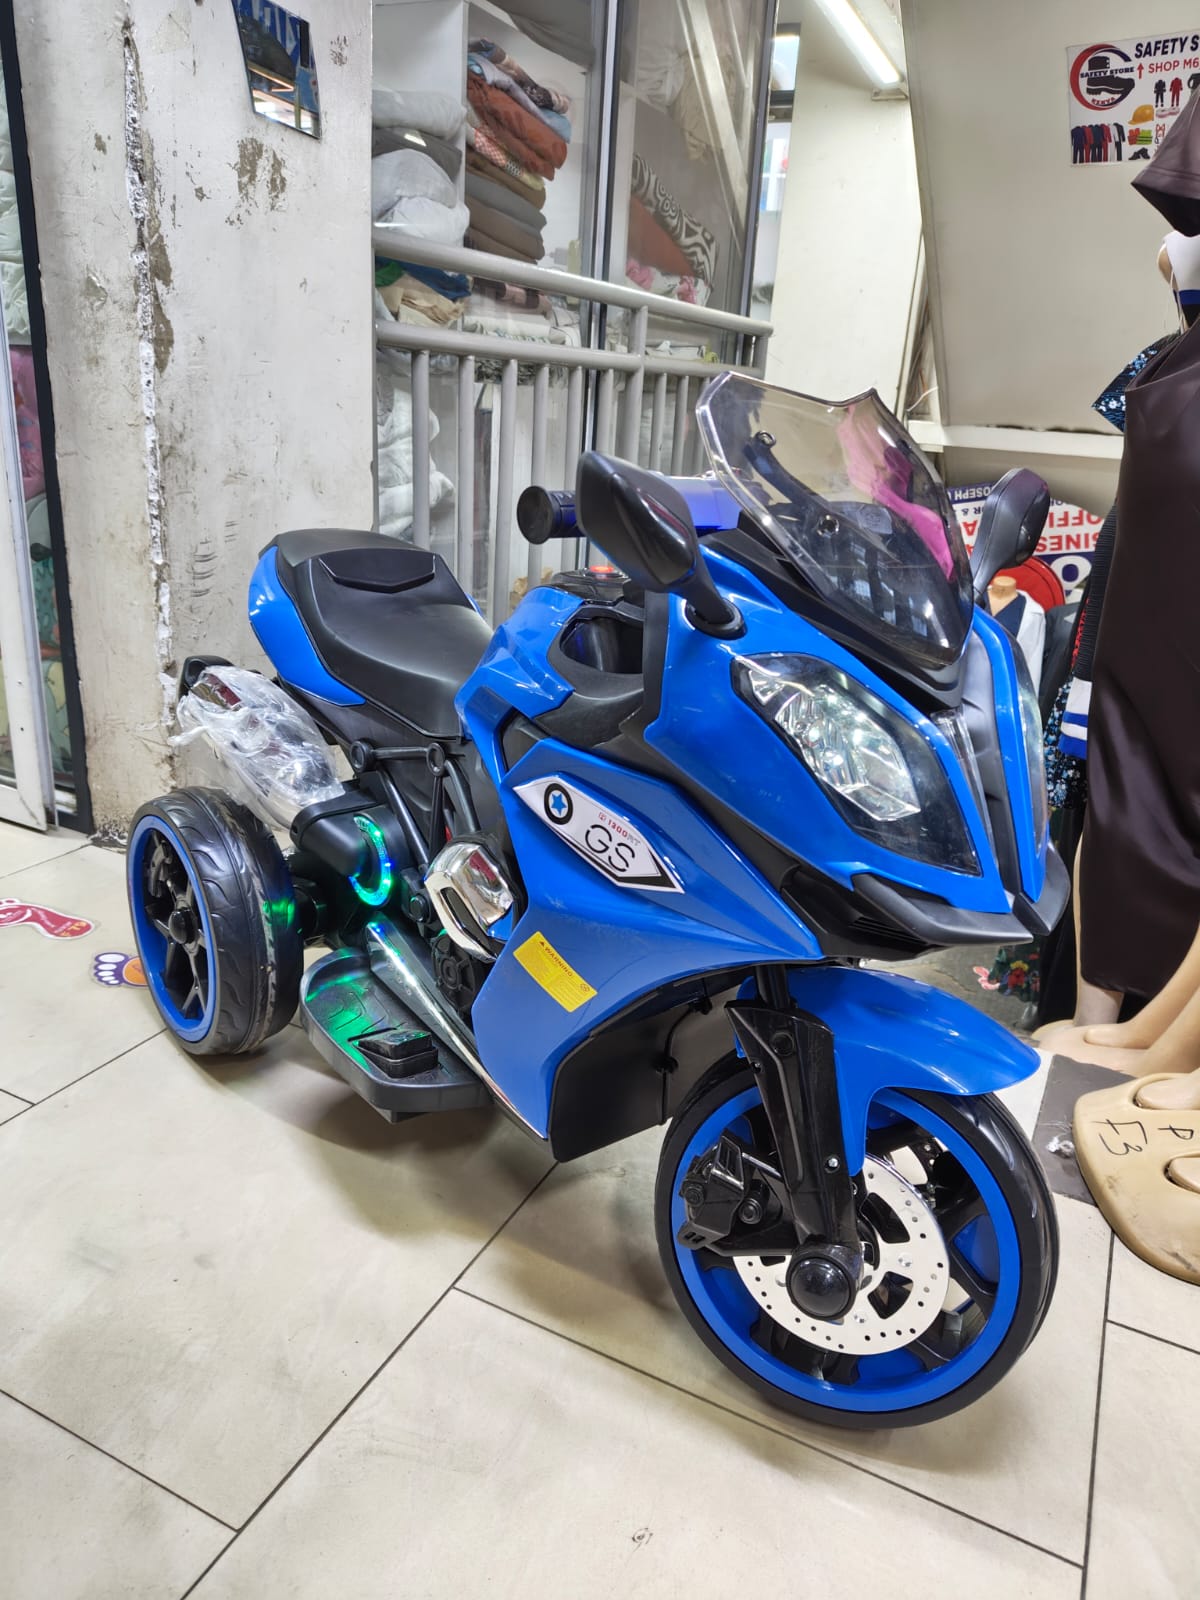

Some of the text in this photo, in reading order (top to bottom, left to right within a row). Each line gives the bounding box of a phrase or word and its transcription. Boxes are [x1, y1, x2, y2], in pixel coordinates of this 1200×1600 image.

[1135, 36, 1188, 58] SAFETY
[1080, 67, 1135, 78] SAFETY STORE
[1148, 60, 1180, 73] SHOP
[585, 824, 635, 873] GS
[545, 947, 573, 977] WARNING
